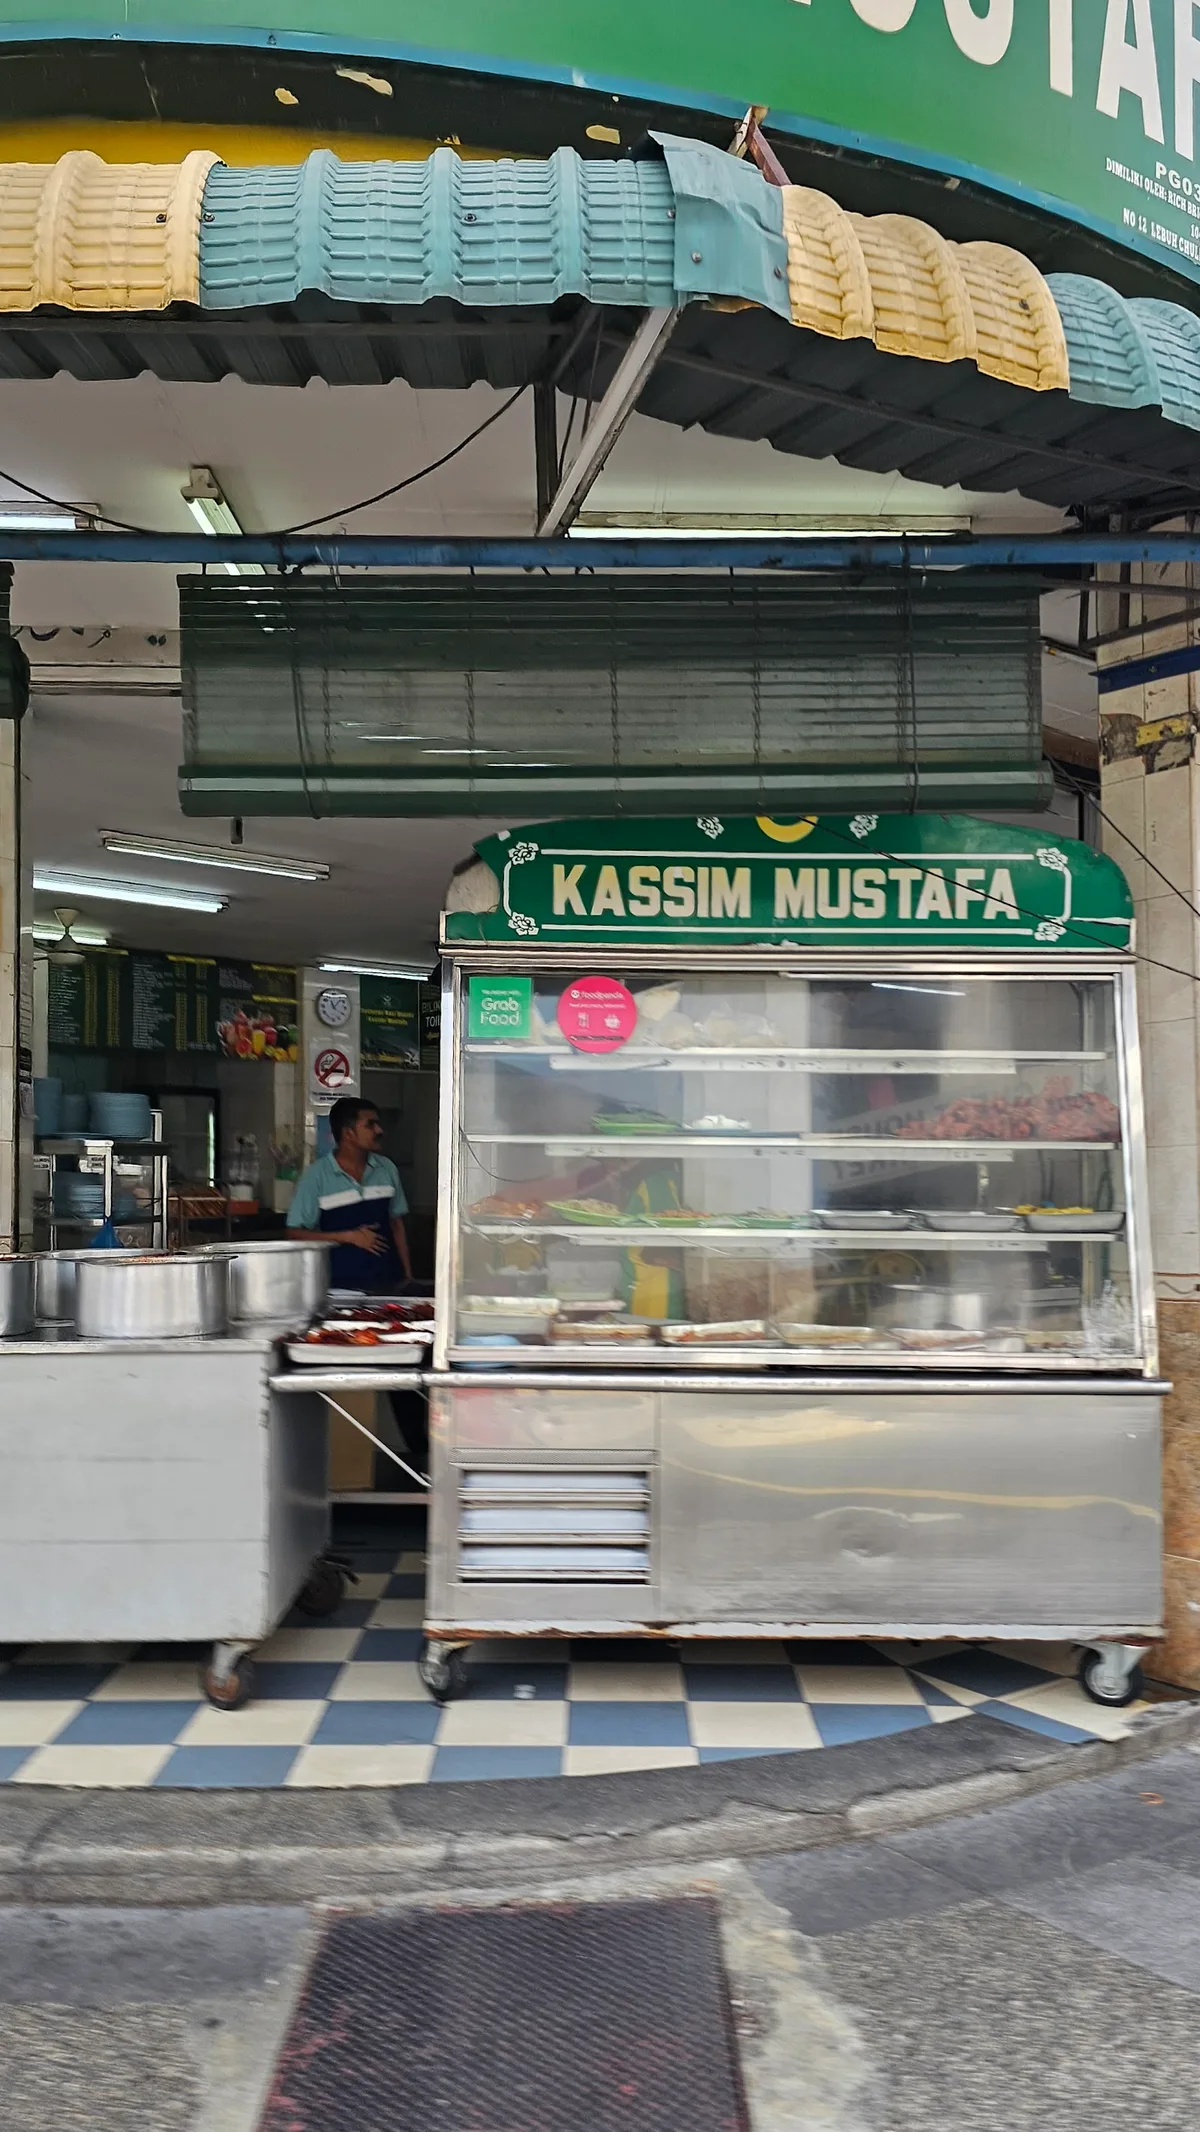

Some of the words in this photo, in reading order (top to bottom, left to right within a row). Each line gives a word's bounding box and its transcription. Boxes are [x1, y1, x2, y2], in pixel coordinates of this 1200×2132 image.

[1106, 157, 1143, 187] DIMILIKI
[1144, 177, 1168, 201] OLEH:
[1168, 190, 1187, 213] RICH
[1123, 207, 1136, 227] NO
[1138, 215, 1148, 234] 12
[1151, 221, 1178, 249] LEBUH
[1178, 236, 1200, 262] CHUL
[553, 863, 752, 918] KASSIM
[773, 866, 1020, 921] MUSTAFA
[481, 996, 519, 1012] Grab
[481, 1010, 519, 1027] Food
